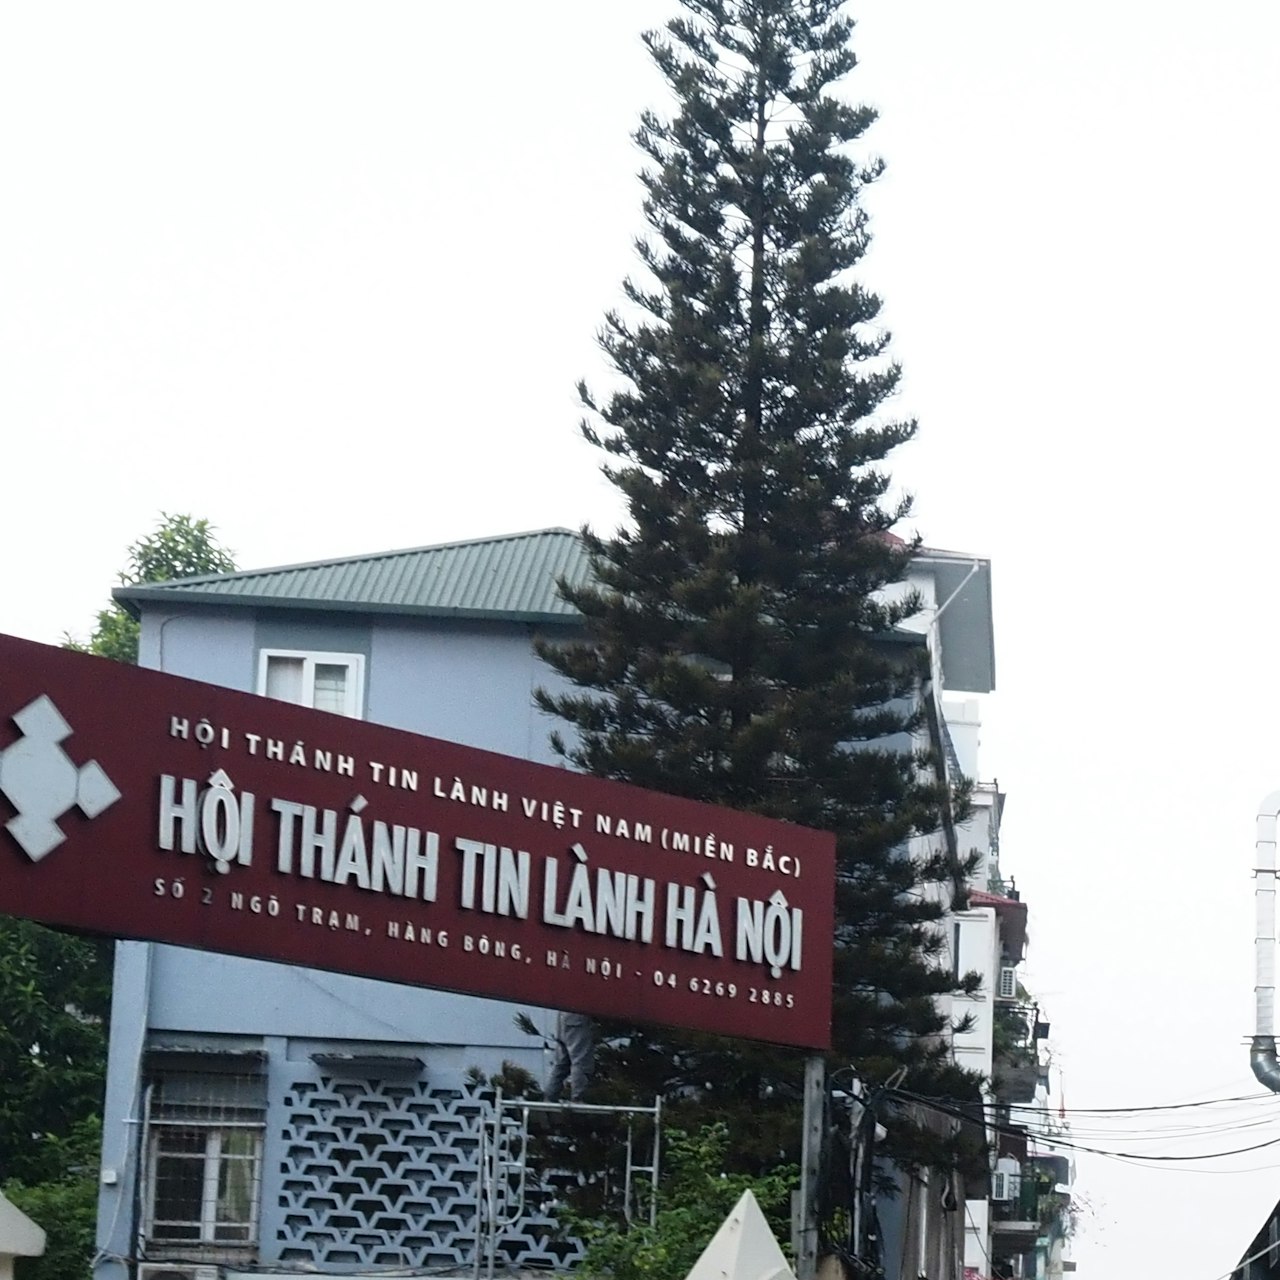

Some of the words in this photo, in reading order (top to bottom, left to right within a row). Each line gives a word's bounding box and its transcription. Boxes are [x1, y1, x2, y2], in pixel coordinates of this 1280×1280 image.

[158, 767, 256, 875] HỘI
[271, 793, 440, 903] THÁNH
[455, 836, 532, 921] TIN
[543, 842, 657, 945] LÀNH
[665, 871, 725, 958] HÀ
[736, 889, 804, 980] NỘI
[170, 716, 231, 754] HỘI
[245, 733, 355, 777] THÁNH
[369, 761, 419, 792] TIN
[433, 776, 509, 813] LÀNH
[521, 796, 584, 834] VIỆT
[596, 813, 653, 844] NAM
[660, 827, 735, 863] (MIỀN
[746, 844, 802, 878] BẮC)
[153, 877, 186, 899] SỐ
[202, 887, 213, 905] 2
[295, 904, 372, 937] TRẠM,
[387, 920, 449, 948] HÀNG
[463, 933, 532, 964] BÔNG,
[546, 951, 571, 975] HÀ
[586, 956, 622, 981] NỘI
[653, 970, 678, 989] 04
[688, 976, 738, 998] 6269
[748, 986, 796, 1009] 2885
